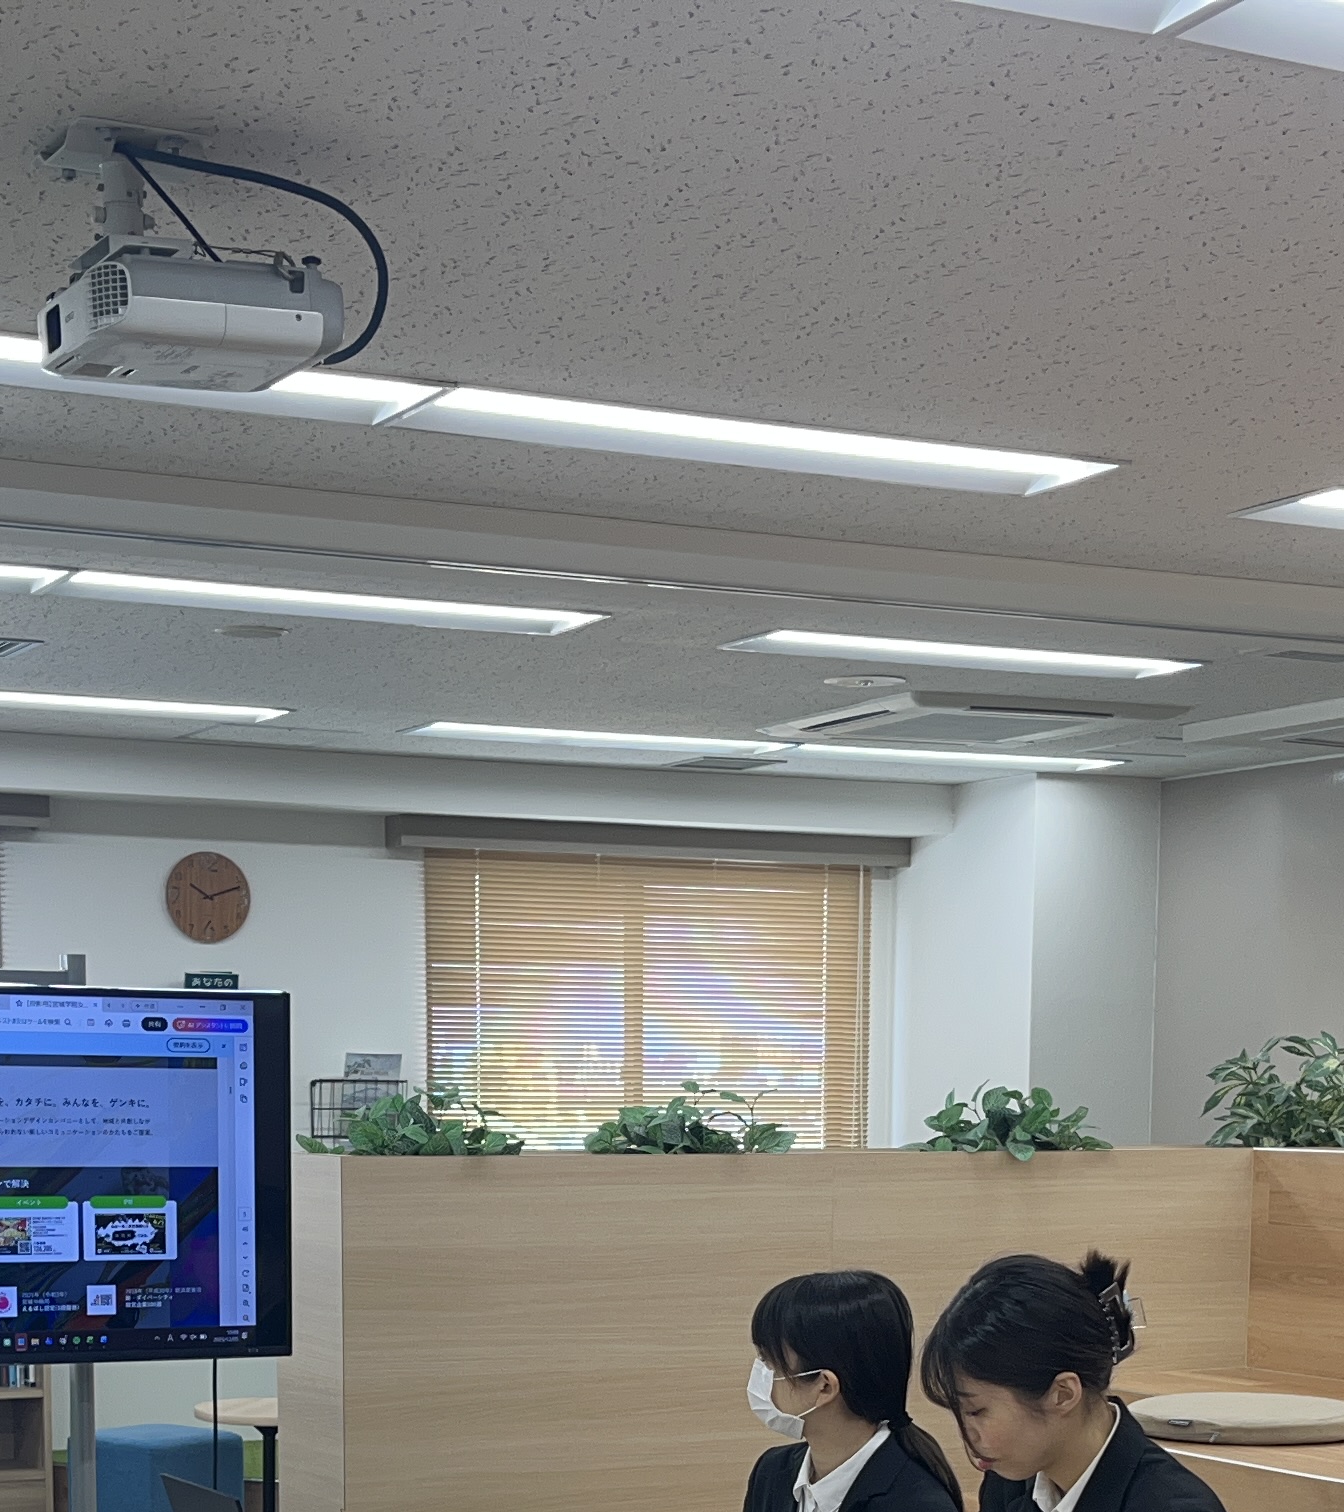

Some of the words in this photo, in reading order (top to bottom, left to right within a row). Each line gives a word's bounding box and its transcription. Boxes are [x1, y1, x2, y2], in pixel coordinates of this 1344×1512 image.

[191, 977, 234, 988] あなたの
[17, 1199, 42, 1207] イベント
